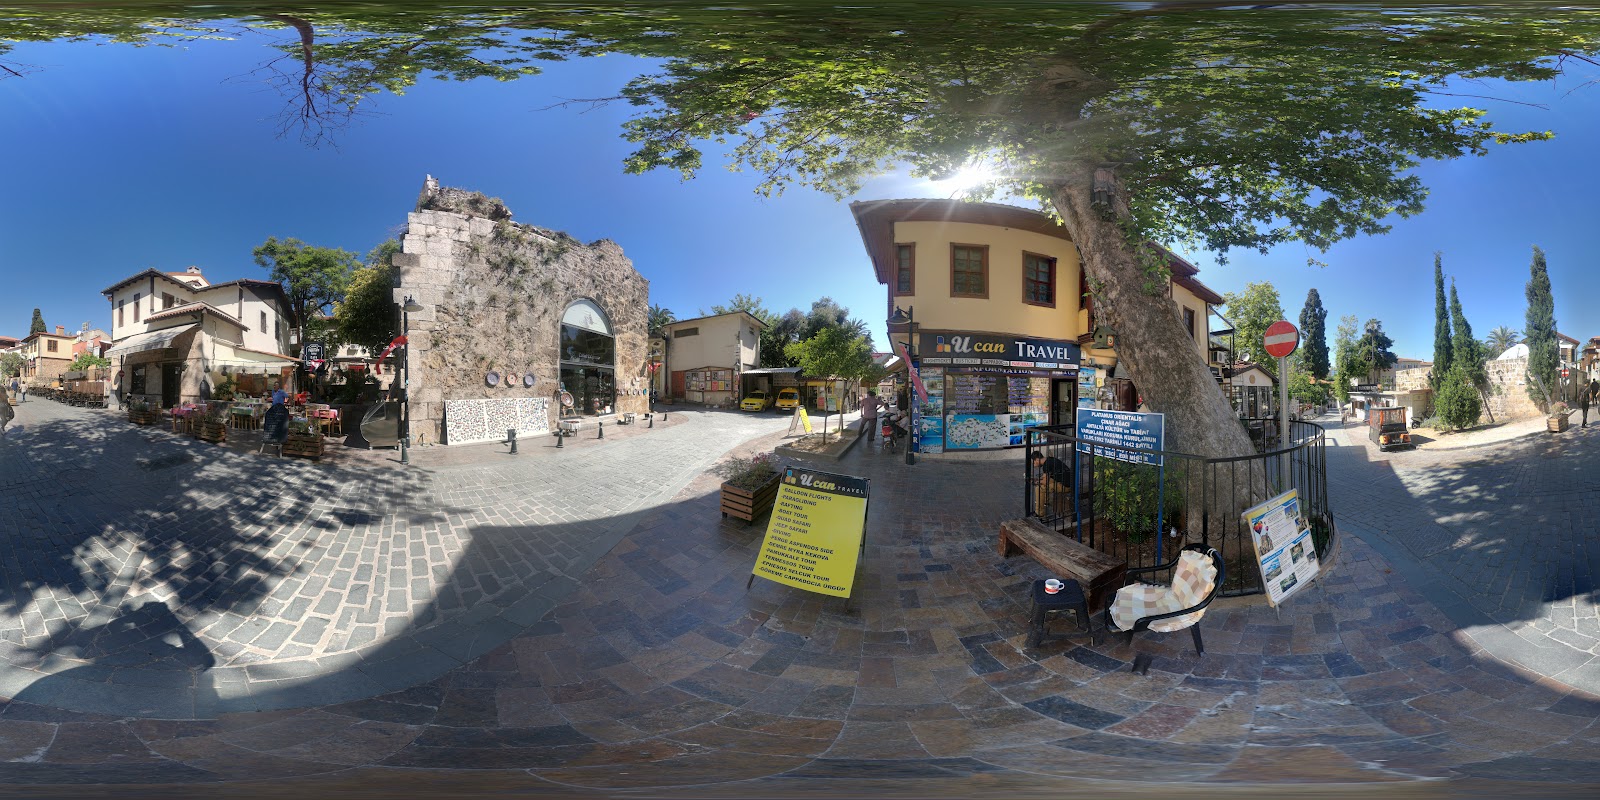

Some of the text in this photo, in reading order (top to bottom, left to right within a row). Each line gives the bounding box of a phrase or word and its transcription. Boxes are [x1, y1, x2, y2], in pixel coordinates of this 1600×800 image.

[1015, 341, 1071, 360] TRAVEL
[838, 486, 864, 494] TRAVEL
[809, 493, 832, 501] FLIGHTS
[793, 519, 811, 527] SAFARI
[789, 526, 808, 534] SAFARI
[789, 540, 818, 551] ASPENDOS
[789, 547, 804, 555] MYRA
[805, 552, 829, 560] KEKOVA
[798, 564, 814, 572] TOUR
[784, 574, 821, 587] CAPPADOCIA
